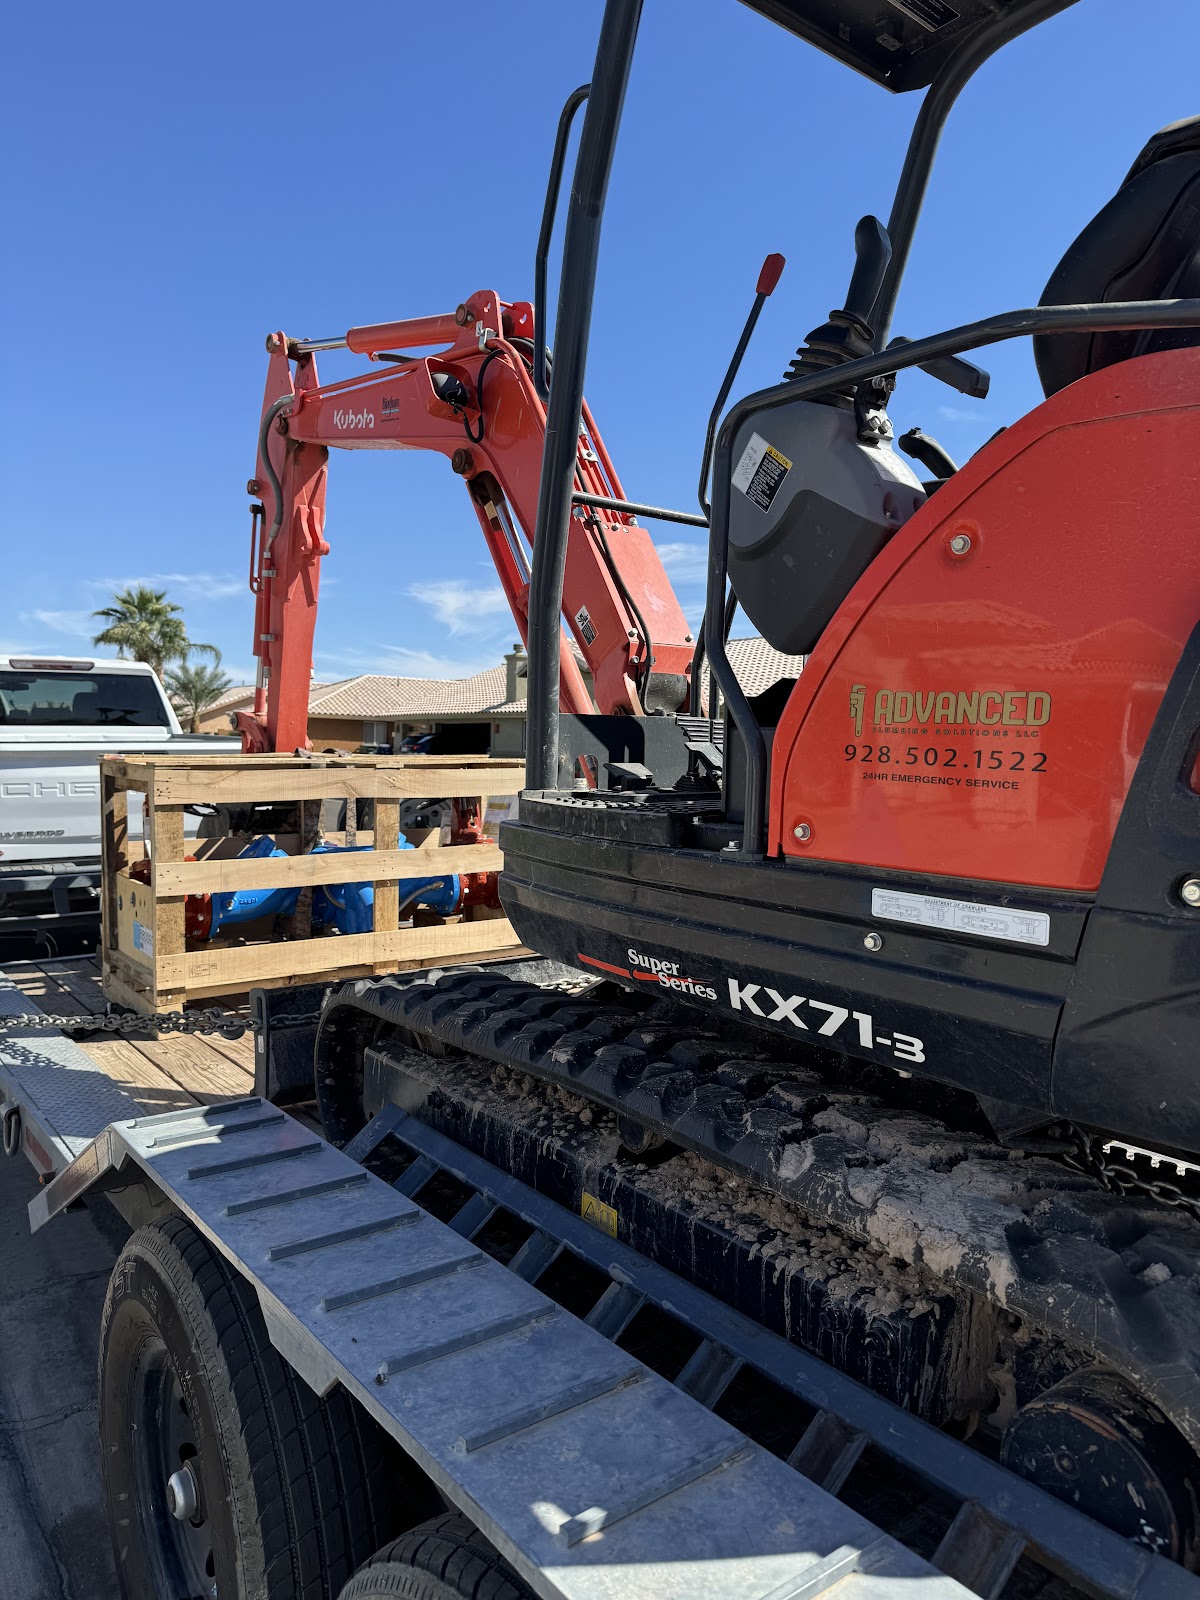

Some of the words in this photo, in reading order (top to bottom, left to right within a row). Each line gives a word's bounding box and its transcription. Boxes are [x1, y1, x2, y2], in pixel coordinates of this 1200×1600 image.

[333, 408, 375, 429] Kubota
[873, 689, 1052, 726] ADVANCED
[872, 726, 929, 735] PLUMBING
[935, 729, 1009, 737] SOLUTIONS
[1016, 730, 1039, 738] LLC
[844, 744, 1048, 772] 928.502.1522
[862, 772, 888, 781] 24HR
[891, 774, 962, 786] EMERGENCY
[965, 778, 1019, 790] SERVICE
[924, 898, 954, 908] ADJUSTMENT
[962, 903, 987, 912] CRAWLERS
[627, 948, 680, 976] Super
[657, 972, 718, 1000] Series
[727, 978, 926, 1063] KX71-3
